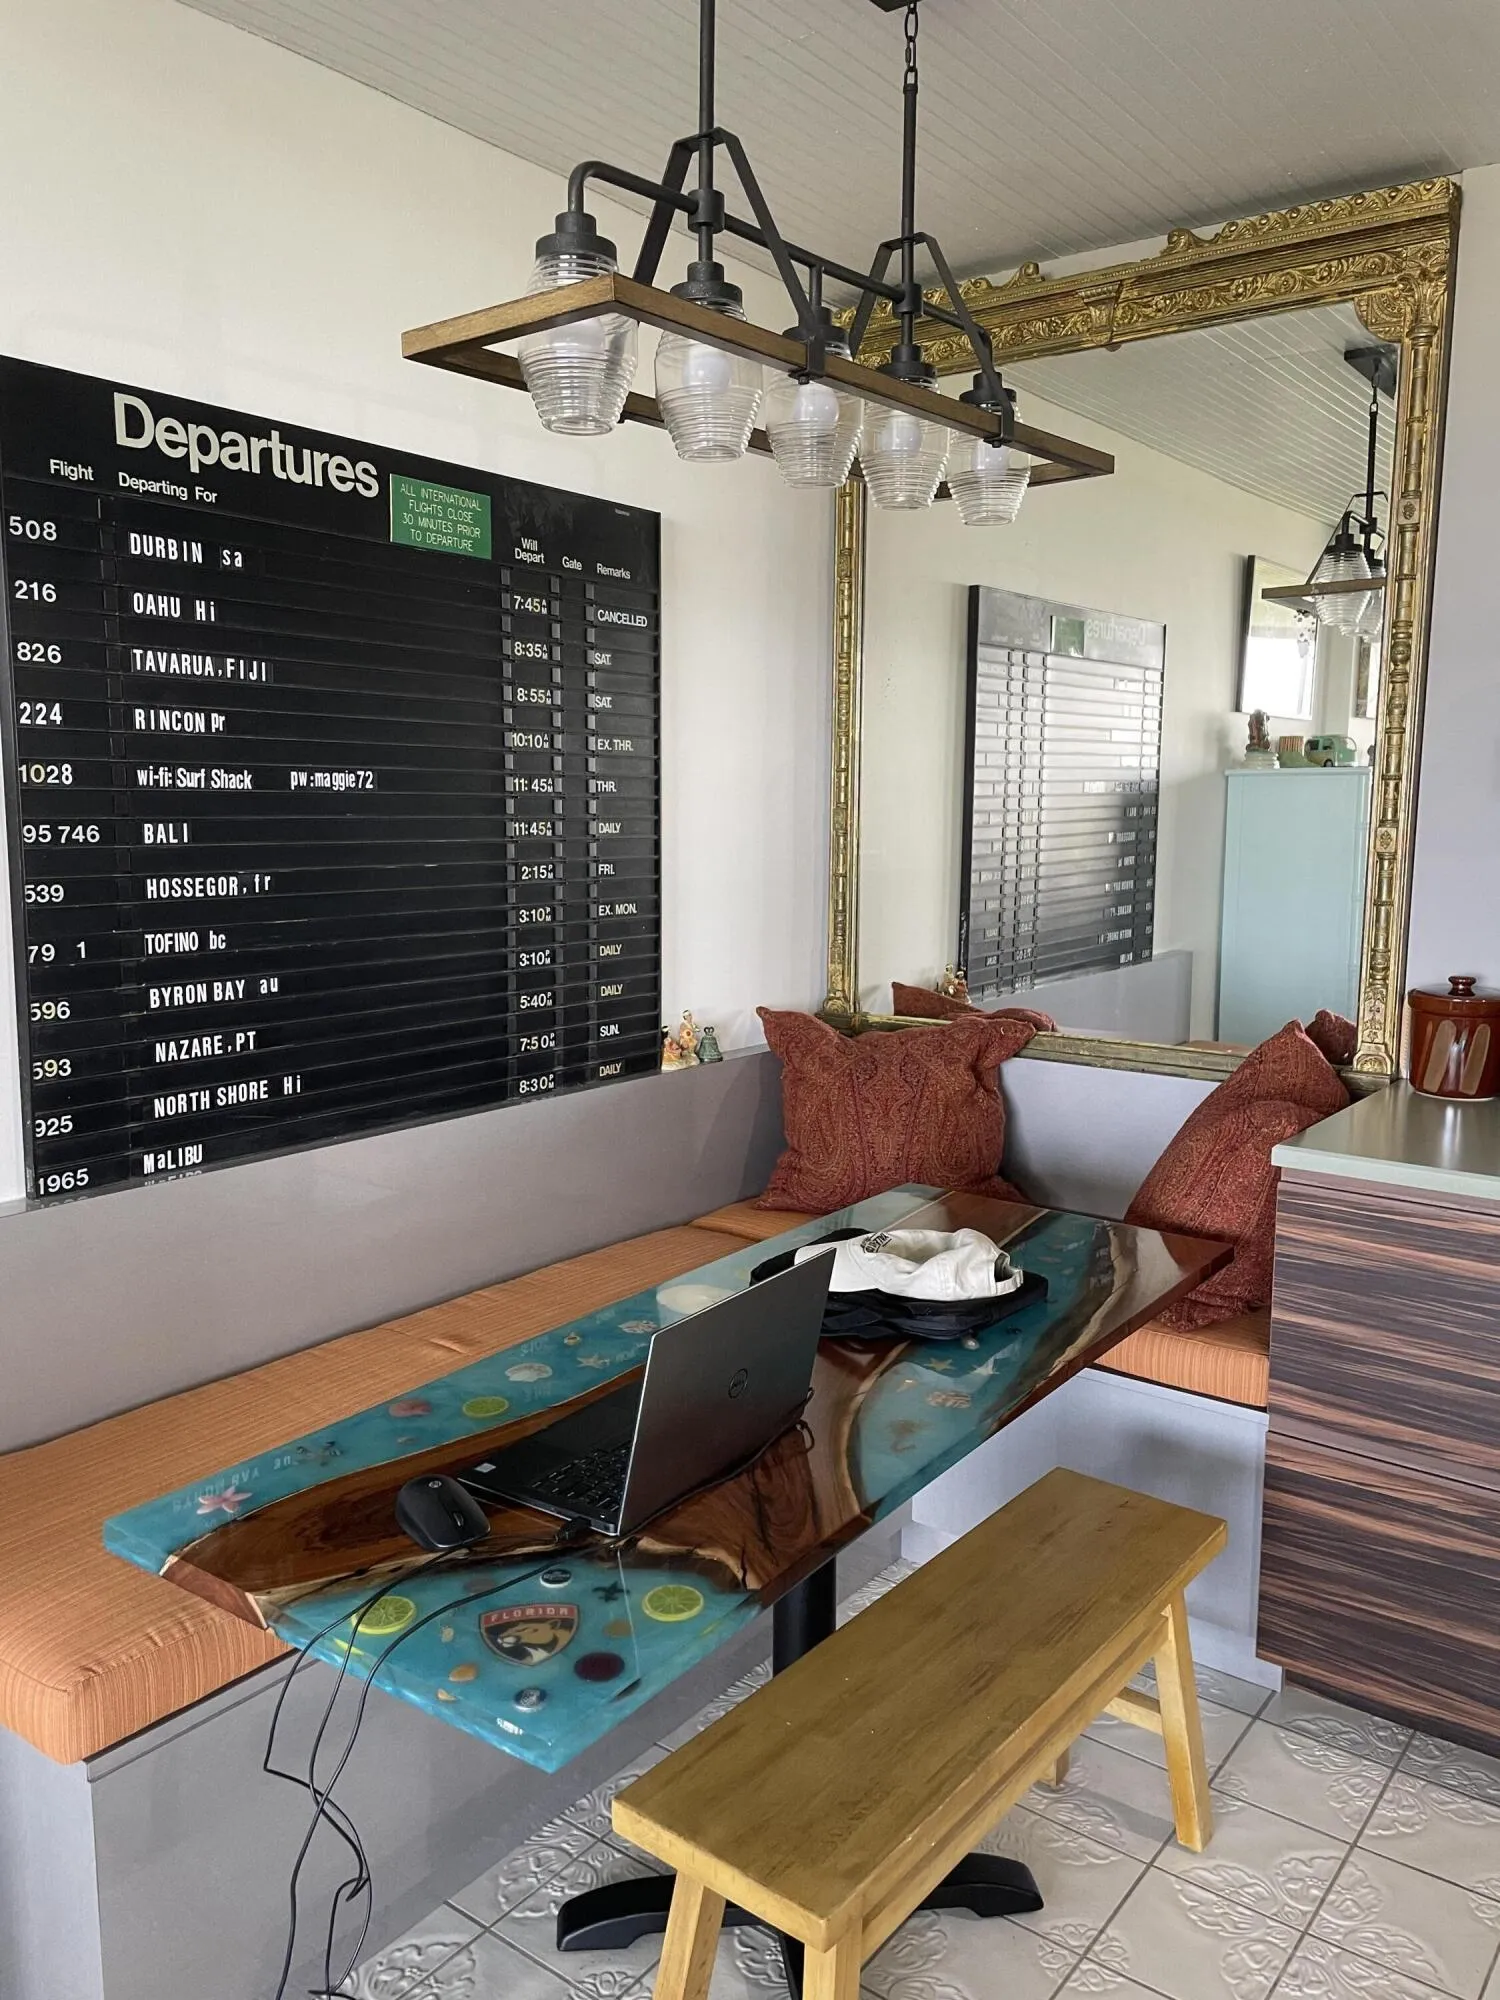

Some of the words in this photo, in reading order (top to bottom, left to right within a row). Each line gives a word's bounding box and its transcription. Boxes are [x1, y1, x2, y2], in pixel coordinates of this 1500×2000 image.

[113, 391, 380, 498] Departures
[50, 459, 94, 481] Flight
[118, 472, 188, 500] Departing
[195, 487, 218, 503] For
[400, 483, 416, 497] ALL
[420, 488, 482, 511] INTERNATIONAL
[409, 499, 442, 517] FLIGHTS
[448, 508, 474, 524] CLOSE
[9, 516, 57, 541] 508
[402, 512, 414, 525] 30
[418, 516, 453, 533] MINUTES
[457, 524, 481, 538] PRIOR
[130, 532, 203, 564] DURBIN
[222, 549, 243, 568] sa
[410, 528, 422, 542] TO
[426, 532, 474, 552] DEPARTURE
[521, 537, 538, 551] Will
[514, 548, 545, 564] Depart
[562, 556, 583, 571] Gate
[596, 563, 631, 580] Remarks
[14, 580, 57, 602] 216
[134, 592, 181, 618] OAHU
[196, 600, 216, 622] Hi
[598, 610, 648, 627] CANCELLED
[17, 642, 62, 664] 826
[19, 702, 62, 726] 224
[134, 708, 206, 733] RINCON
[18, 763, 73, 785] 1028
[176, 768, 206, 788] Surf
[210, 768, 252, 790] Shack
[22, 824, 52, 843] 95
[57, 824, 100, 844] 746
[144, 823, 188, 844] BALI
[598, 822, 622, 834] DAILY
[24, 884, 65, 903] 539
[27, 943, 56, 964] 79
[76, 941, 86, 959] 1
[144, 931, 199, 955] TOFINO
[209, 930, 226, 950] bc
[600, 944, 622, 957] DAILY
[150, 983, 208, 1010] BYRON
[214, 979, 246, 1000] BAY
[260, 977, 279, 995] au
[600, 983, 623, 996] DAILY
[30, 1001, 71, 1021] 596
[32, 1058, 72, 1080] 593
[600, 1062, 622, 1077] DAILY
[154, 1090, 210, 1119] NORTH
[216, 1079, 268, 1106] SHORE
[283, 1074, 301, 1096] Hi
[35, 1114, 73, 1138] 925
[143, 1144, 203, 1175] MaLIBU
[38, 1168, 90, 1196] 1965
[491, 1606, 570, 1622] FLORIDA
